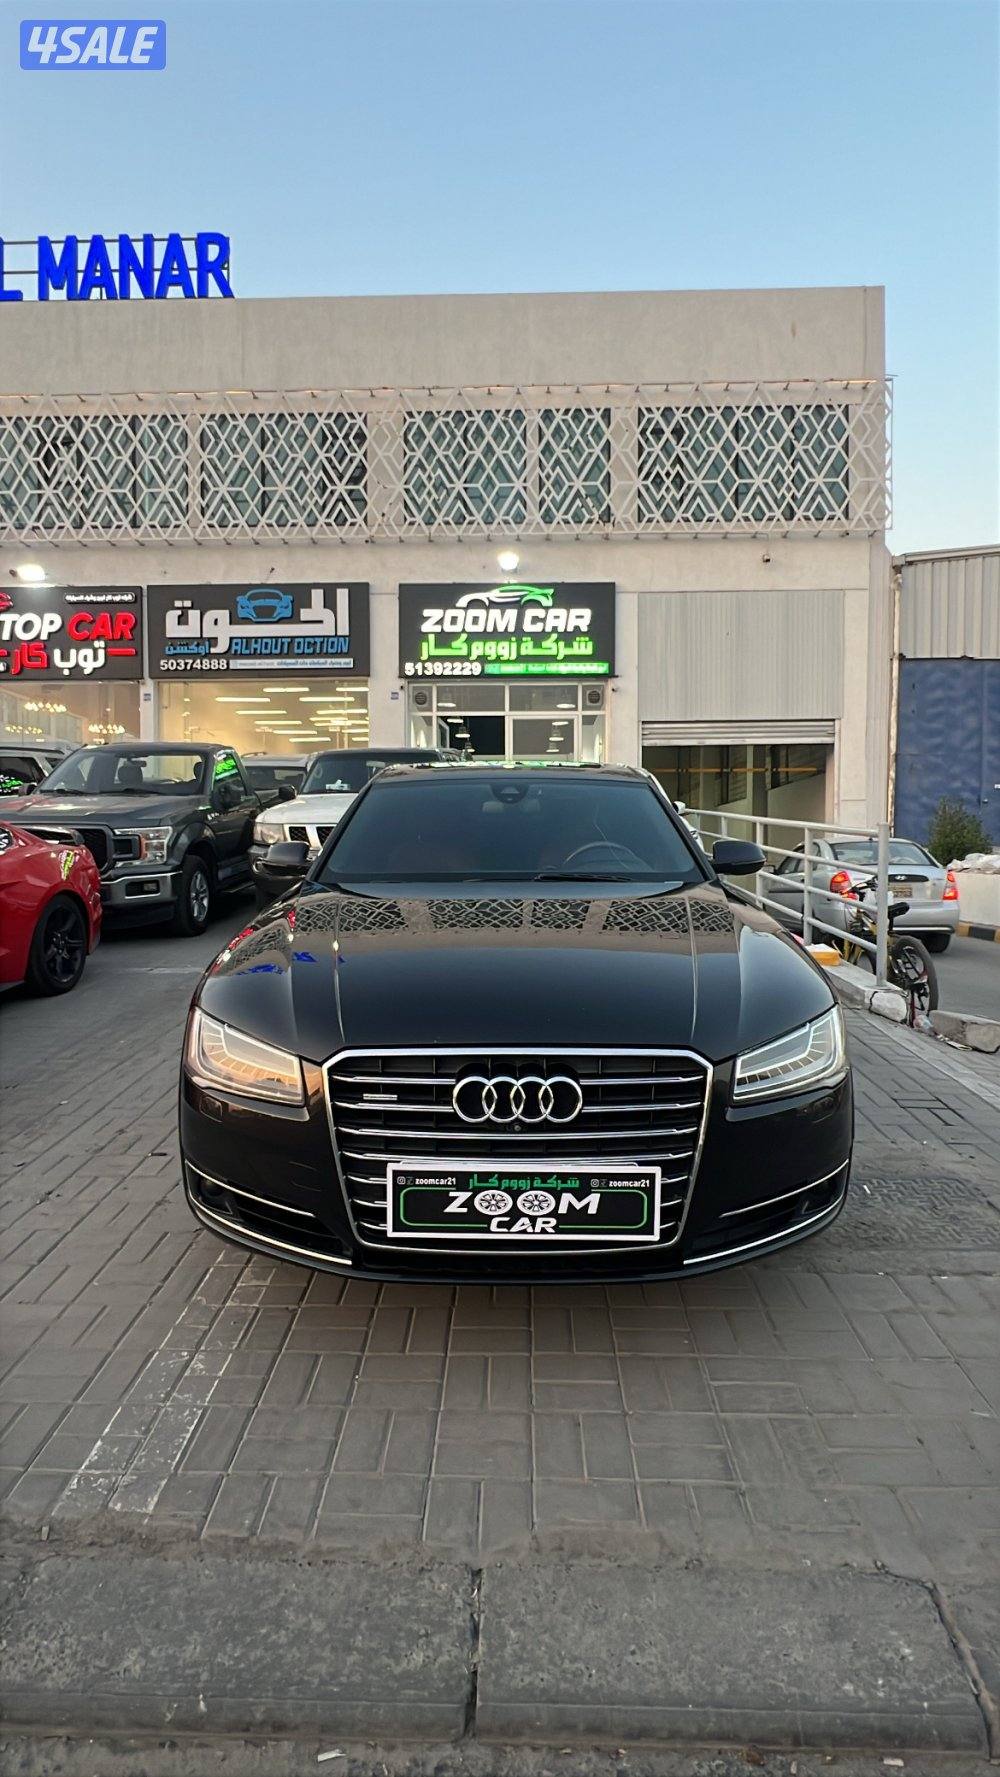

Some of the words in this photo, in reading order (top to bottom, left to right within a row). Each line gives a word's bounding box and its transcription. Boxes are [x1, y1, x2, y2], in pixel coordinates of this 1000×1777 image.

[38, 232, 235, 300] MANAR
[0, 612, 63, 640] TOP
[67, 611, 137, 641] CAR
[165, 588, 350, 653] الحوت
[420, 608, 518, 633] ZOOM
[521, 607, 593, 633] CAR
[53, 640, 106, 676] توب
[230, 637, 291, 655] ALHOUT
[293, 636, 350, 654] OCTION
[420, 633, 468, 661] كار
[469, 636, 518, 661] زووم
[520, 633, 594, 660] شركة
[11, 642, 48, 675] كار
[159, 658, 228, 671] 50374888
[404, 661, 482, 676] 51392229
[414, 1176, 457, 1186] zoomcar21
[468, 1173, 499, 1190] كار
[500, 1177, 531, 1190] زووم
[532, 1174, 580, 1190] شركة
[608, 1179, 651, 1188] zoomcar21
[443, 1189, 601, 1216] ZOOM
[489, 1216, 557, 1233] CAR
